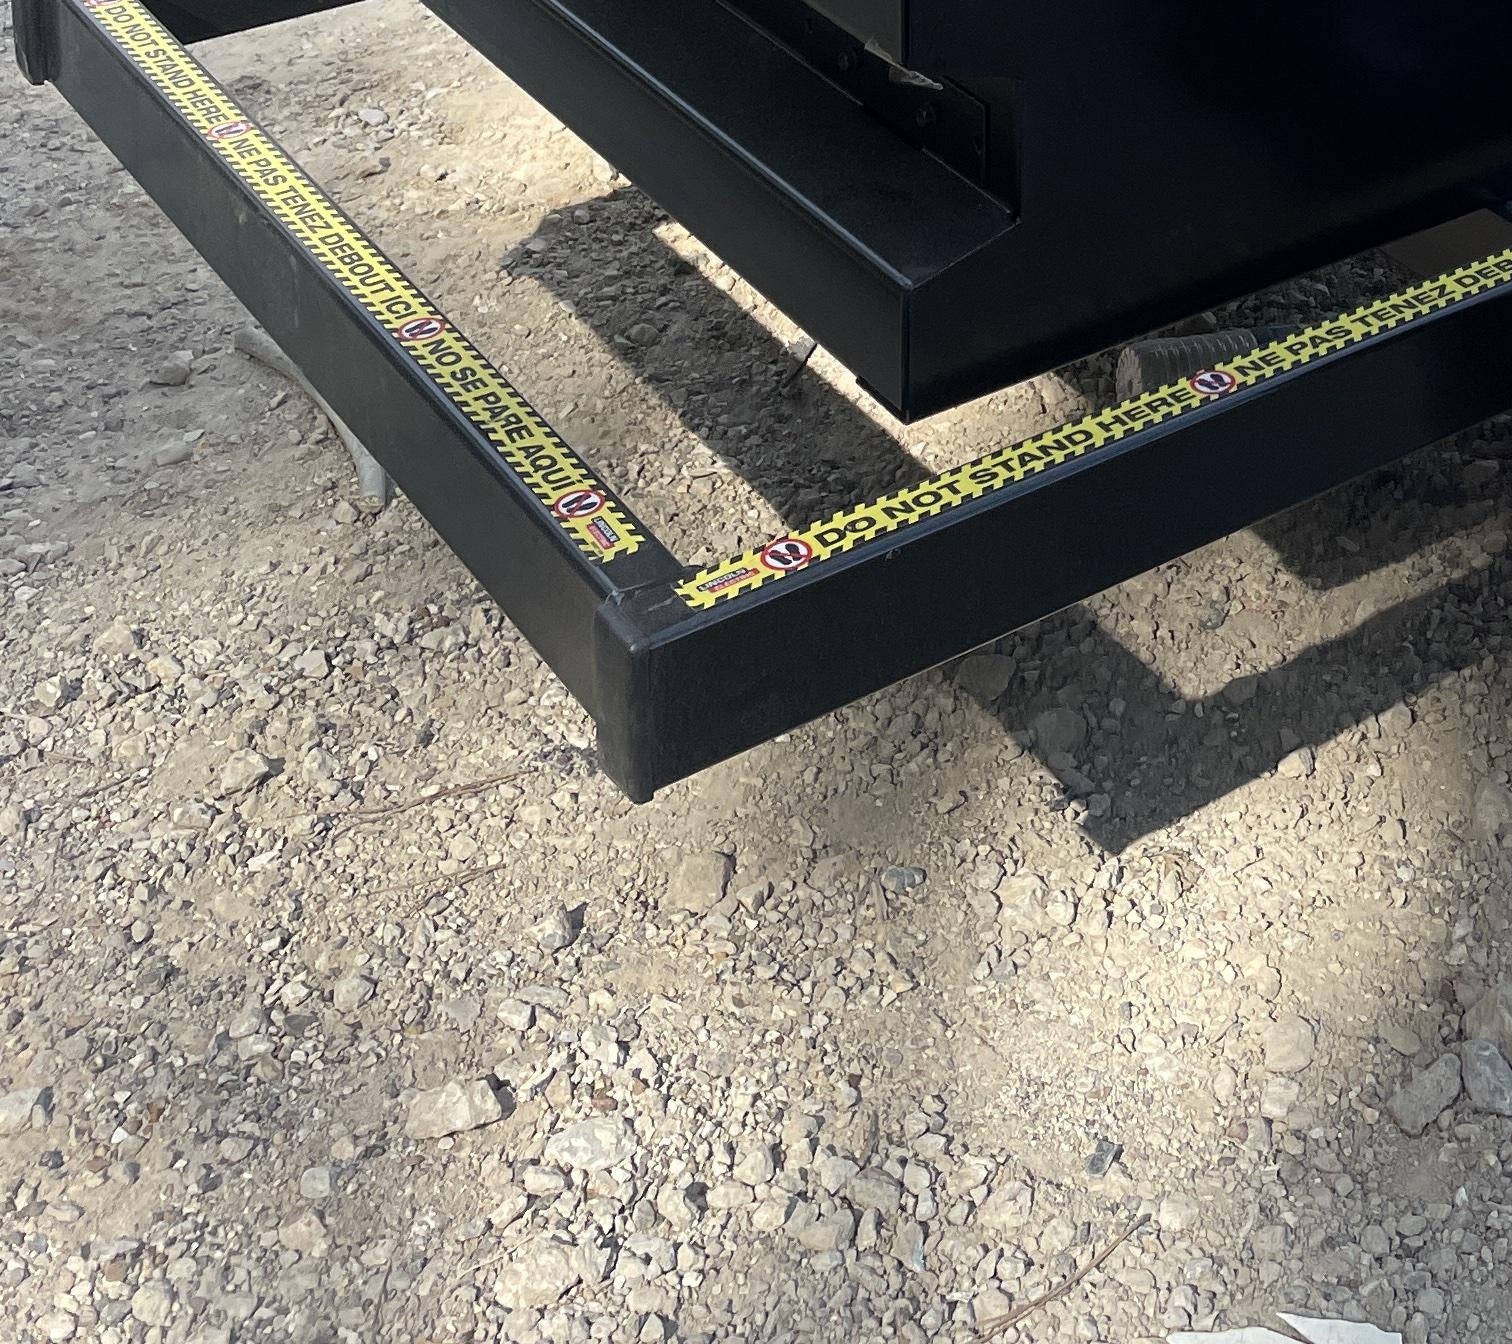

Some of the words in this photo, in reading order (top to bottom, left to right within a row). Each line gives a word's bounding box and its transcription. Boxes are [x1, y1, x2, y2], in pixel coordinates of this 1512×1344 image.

[104, 5, 134, 24] DO
[123, 23, 160, 47] NOT
[145, 49, 195, 89] STAND
[183, 89, 229, 124] HERE
[229, 138, 260, 160] NE
[246, 158, 287, 187] PAS
[276, 186, 334, 233] TENEZ
[318, 232, 397, 294] DEBOUT
[380, 295, 417, 319] ICI
[423, 338, 462, 367] NO
[450, 367, 483, 393] SE
[474, 392, 535, 443] PARE
[813, 516, 878, 550] DO
[882, 480, 964, 521] NOT
[968, 429, 1096, 484] STAND
[1098, 389, 1193, 433] HERE
[1234, 351, 1283, 378] NE
[1286, 324, 1352, 357] PAS
[1354, 284, 1453, 329] TENEZ
[699, 568, 747, 591] LINCOLN
